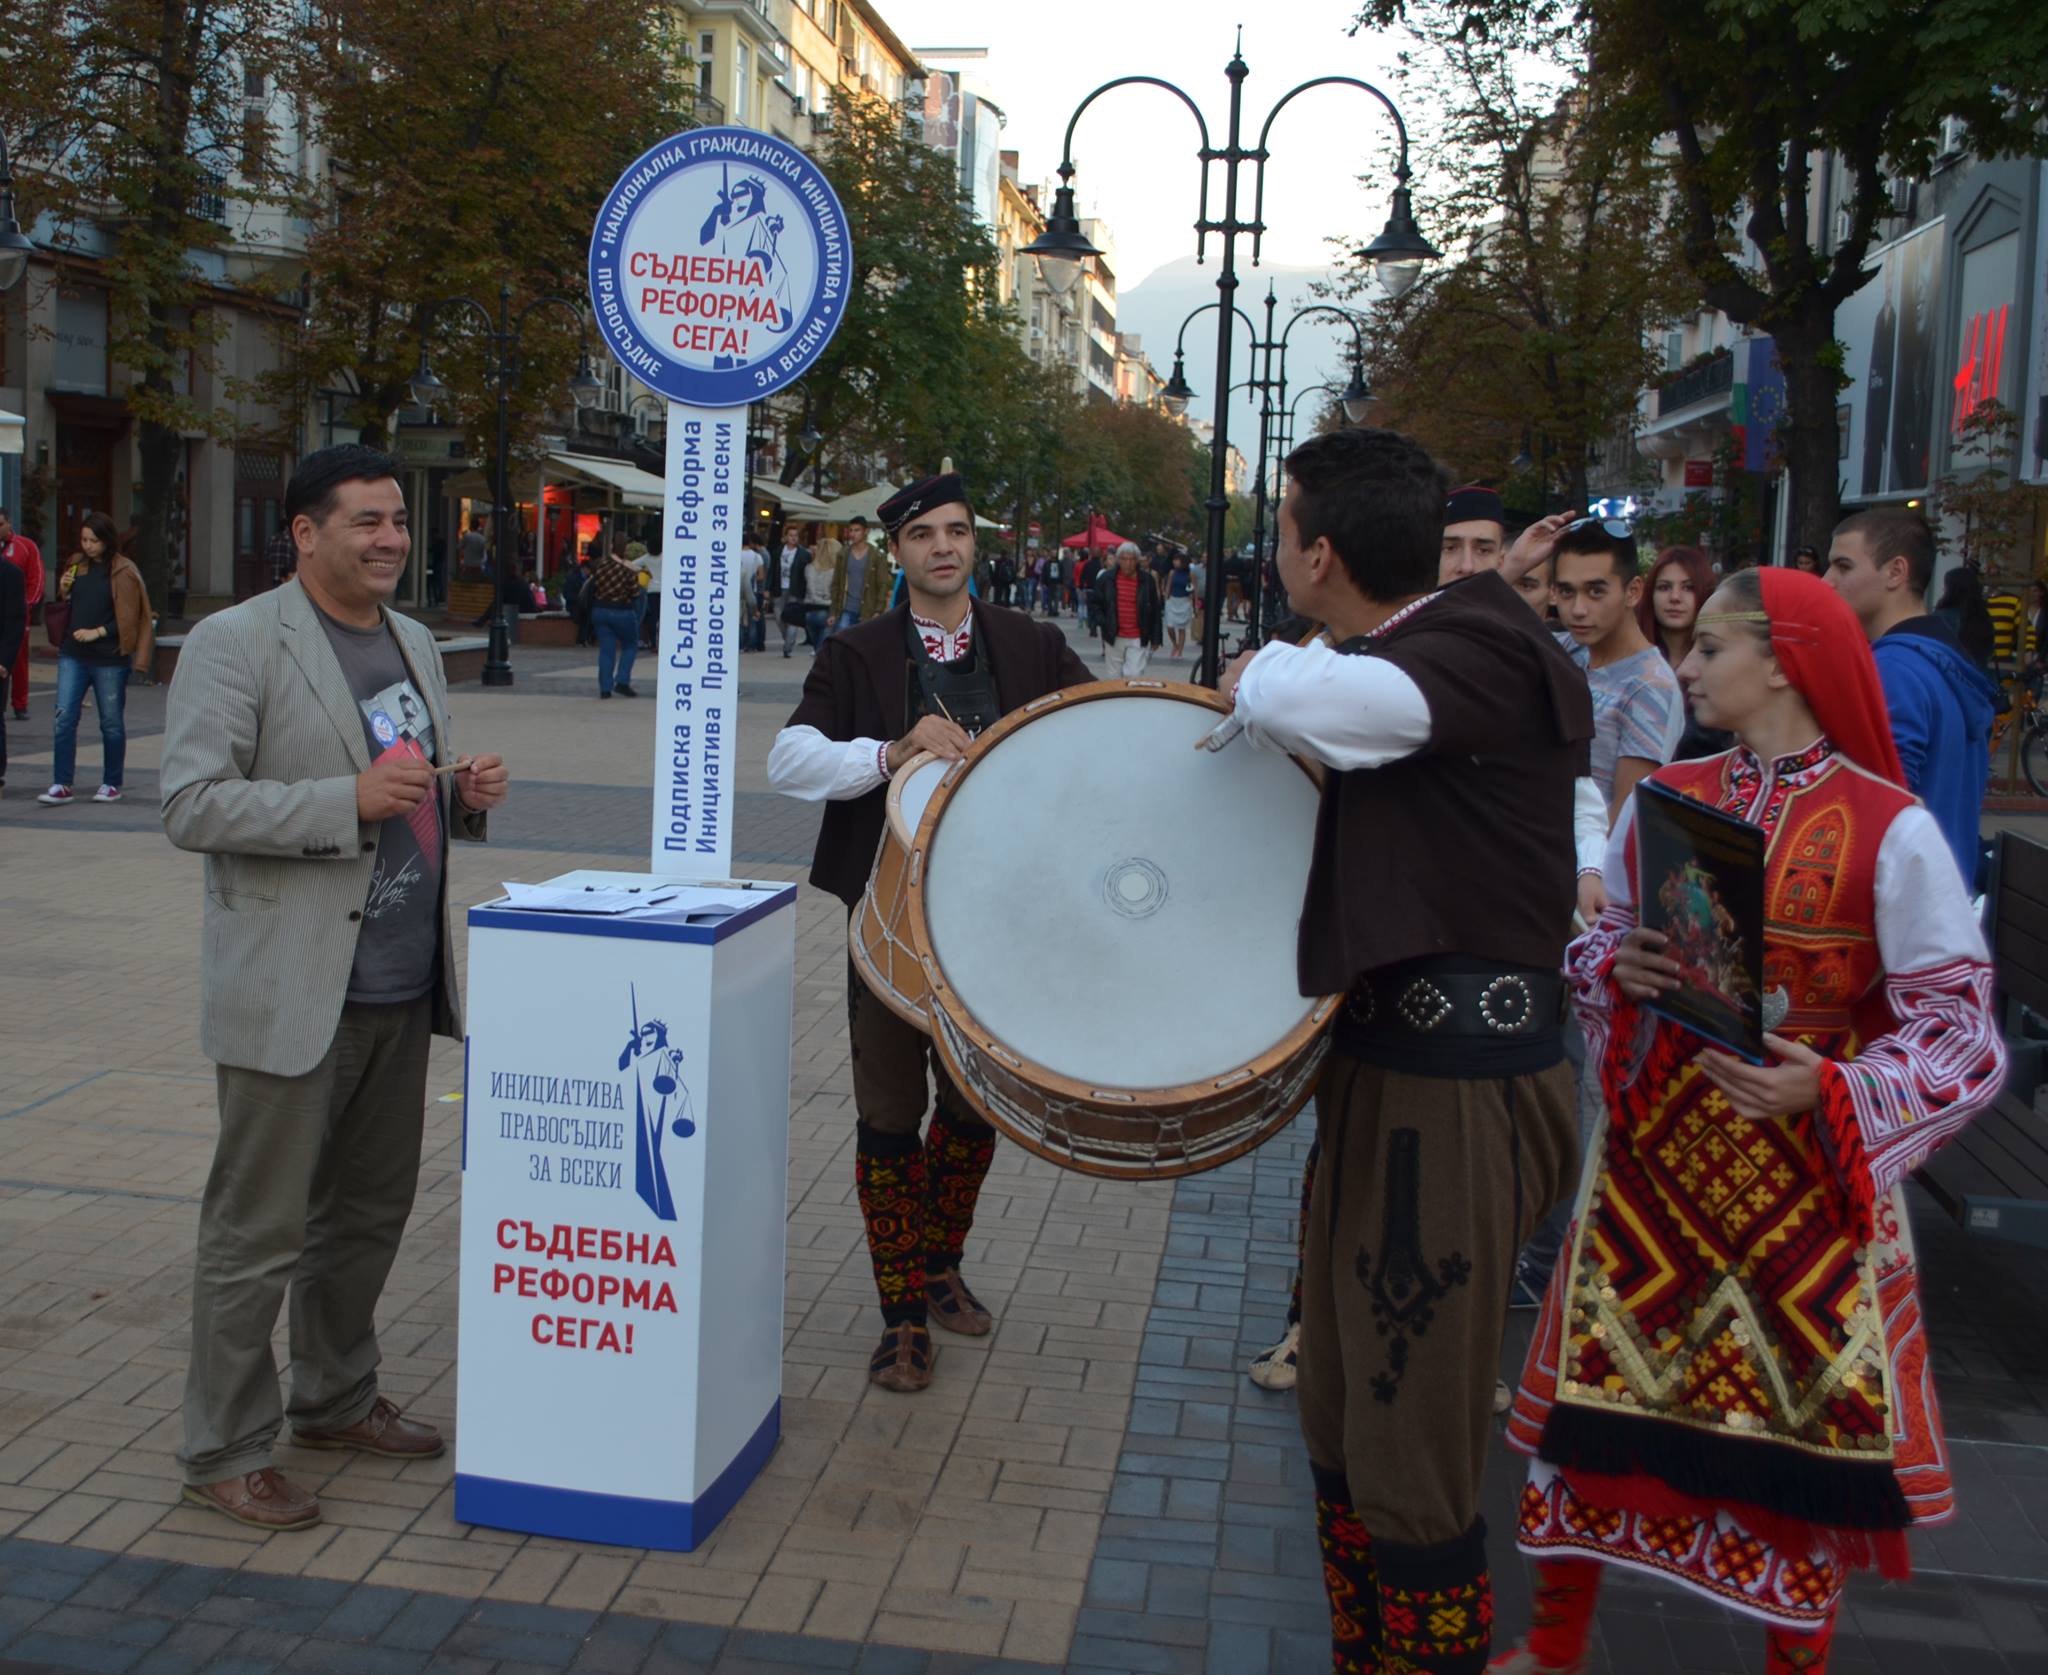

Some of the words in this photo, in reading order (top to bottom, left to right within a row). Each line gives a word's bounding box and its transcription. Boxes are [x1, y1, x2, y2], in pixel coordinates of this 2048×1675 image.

[601, 146, 686, 244] НАЦИОНАЛНА
[689, 136, 802, 181] ГРАЖДАНСКА
[800, 177, 842, 300] ИНИЦИАТИВА
[630, 252, 764, 287] СЪДЕБНА
[598, 267, 662, 378] ПРАВОСЪДИЕ
[754, 370, 779, 387] ЗА
[779, 316, 827, 372] ВСЕКИ
[641, 288, 778, 324] РЕФОРМА
[672, 323, 749, 354] СЕГА!
[675, 421, 705, 540] Реформа
[714, 423, 731, 494] всеки
[713, 504, 728, 531] за
[670, 555, 698, 669] Съдебна
[701, 540, 728, 690] Правосъдие
[675, 682, 692, 711] за
[664, 724, 691, 852] Подписка
[695, 707, 721, 853] Инициатива
[490, 1071, 624, 1111] ИНИЦИАТИВА
[499, 1112, 624, 1150] ПРАВОСЪДИЕ
[529, 1154, 553, 1182] ЗА
[560, 1157, 623, 1189] ВСЕКИ
[496, 1218, 677, 1267] СЪДЕБНА
[493, 1263, 678, 1314] РЕФОРМА
[531, 1313, 634, 1354] СЕГА!
